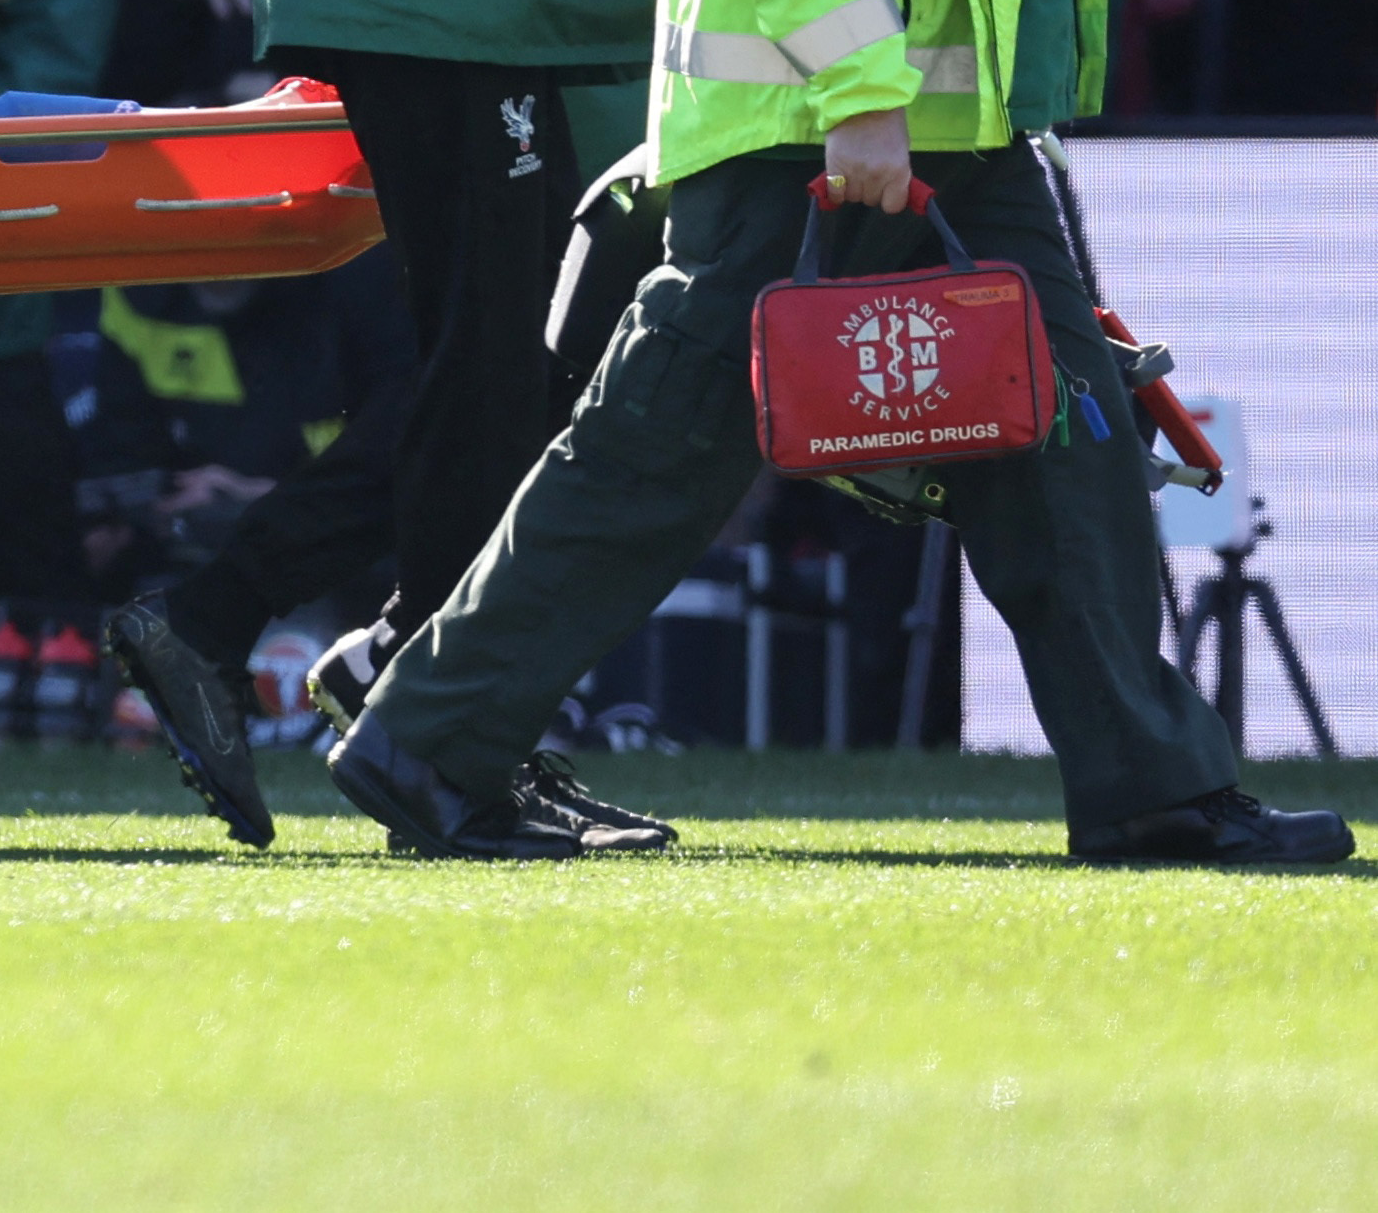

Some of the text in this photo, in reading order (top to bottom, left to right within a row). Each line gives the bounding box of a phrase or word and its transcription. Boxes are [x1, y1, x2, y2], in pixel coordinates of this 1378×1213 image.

[837, 296, 955, 347] AMBULANCE
[859, 341, 938, 371] B M
[849, 385, 951, 421] SERVICE
[810, 423, 1000, 454] PARAMEDIC DRUGS
